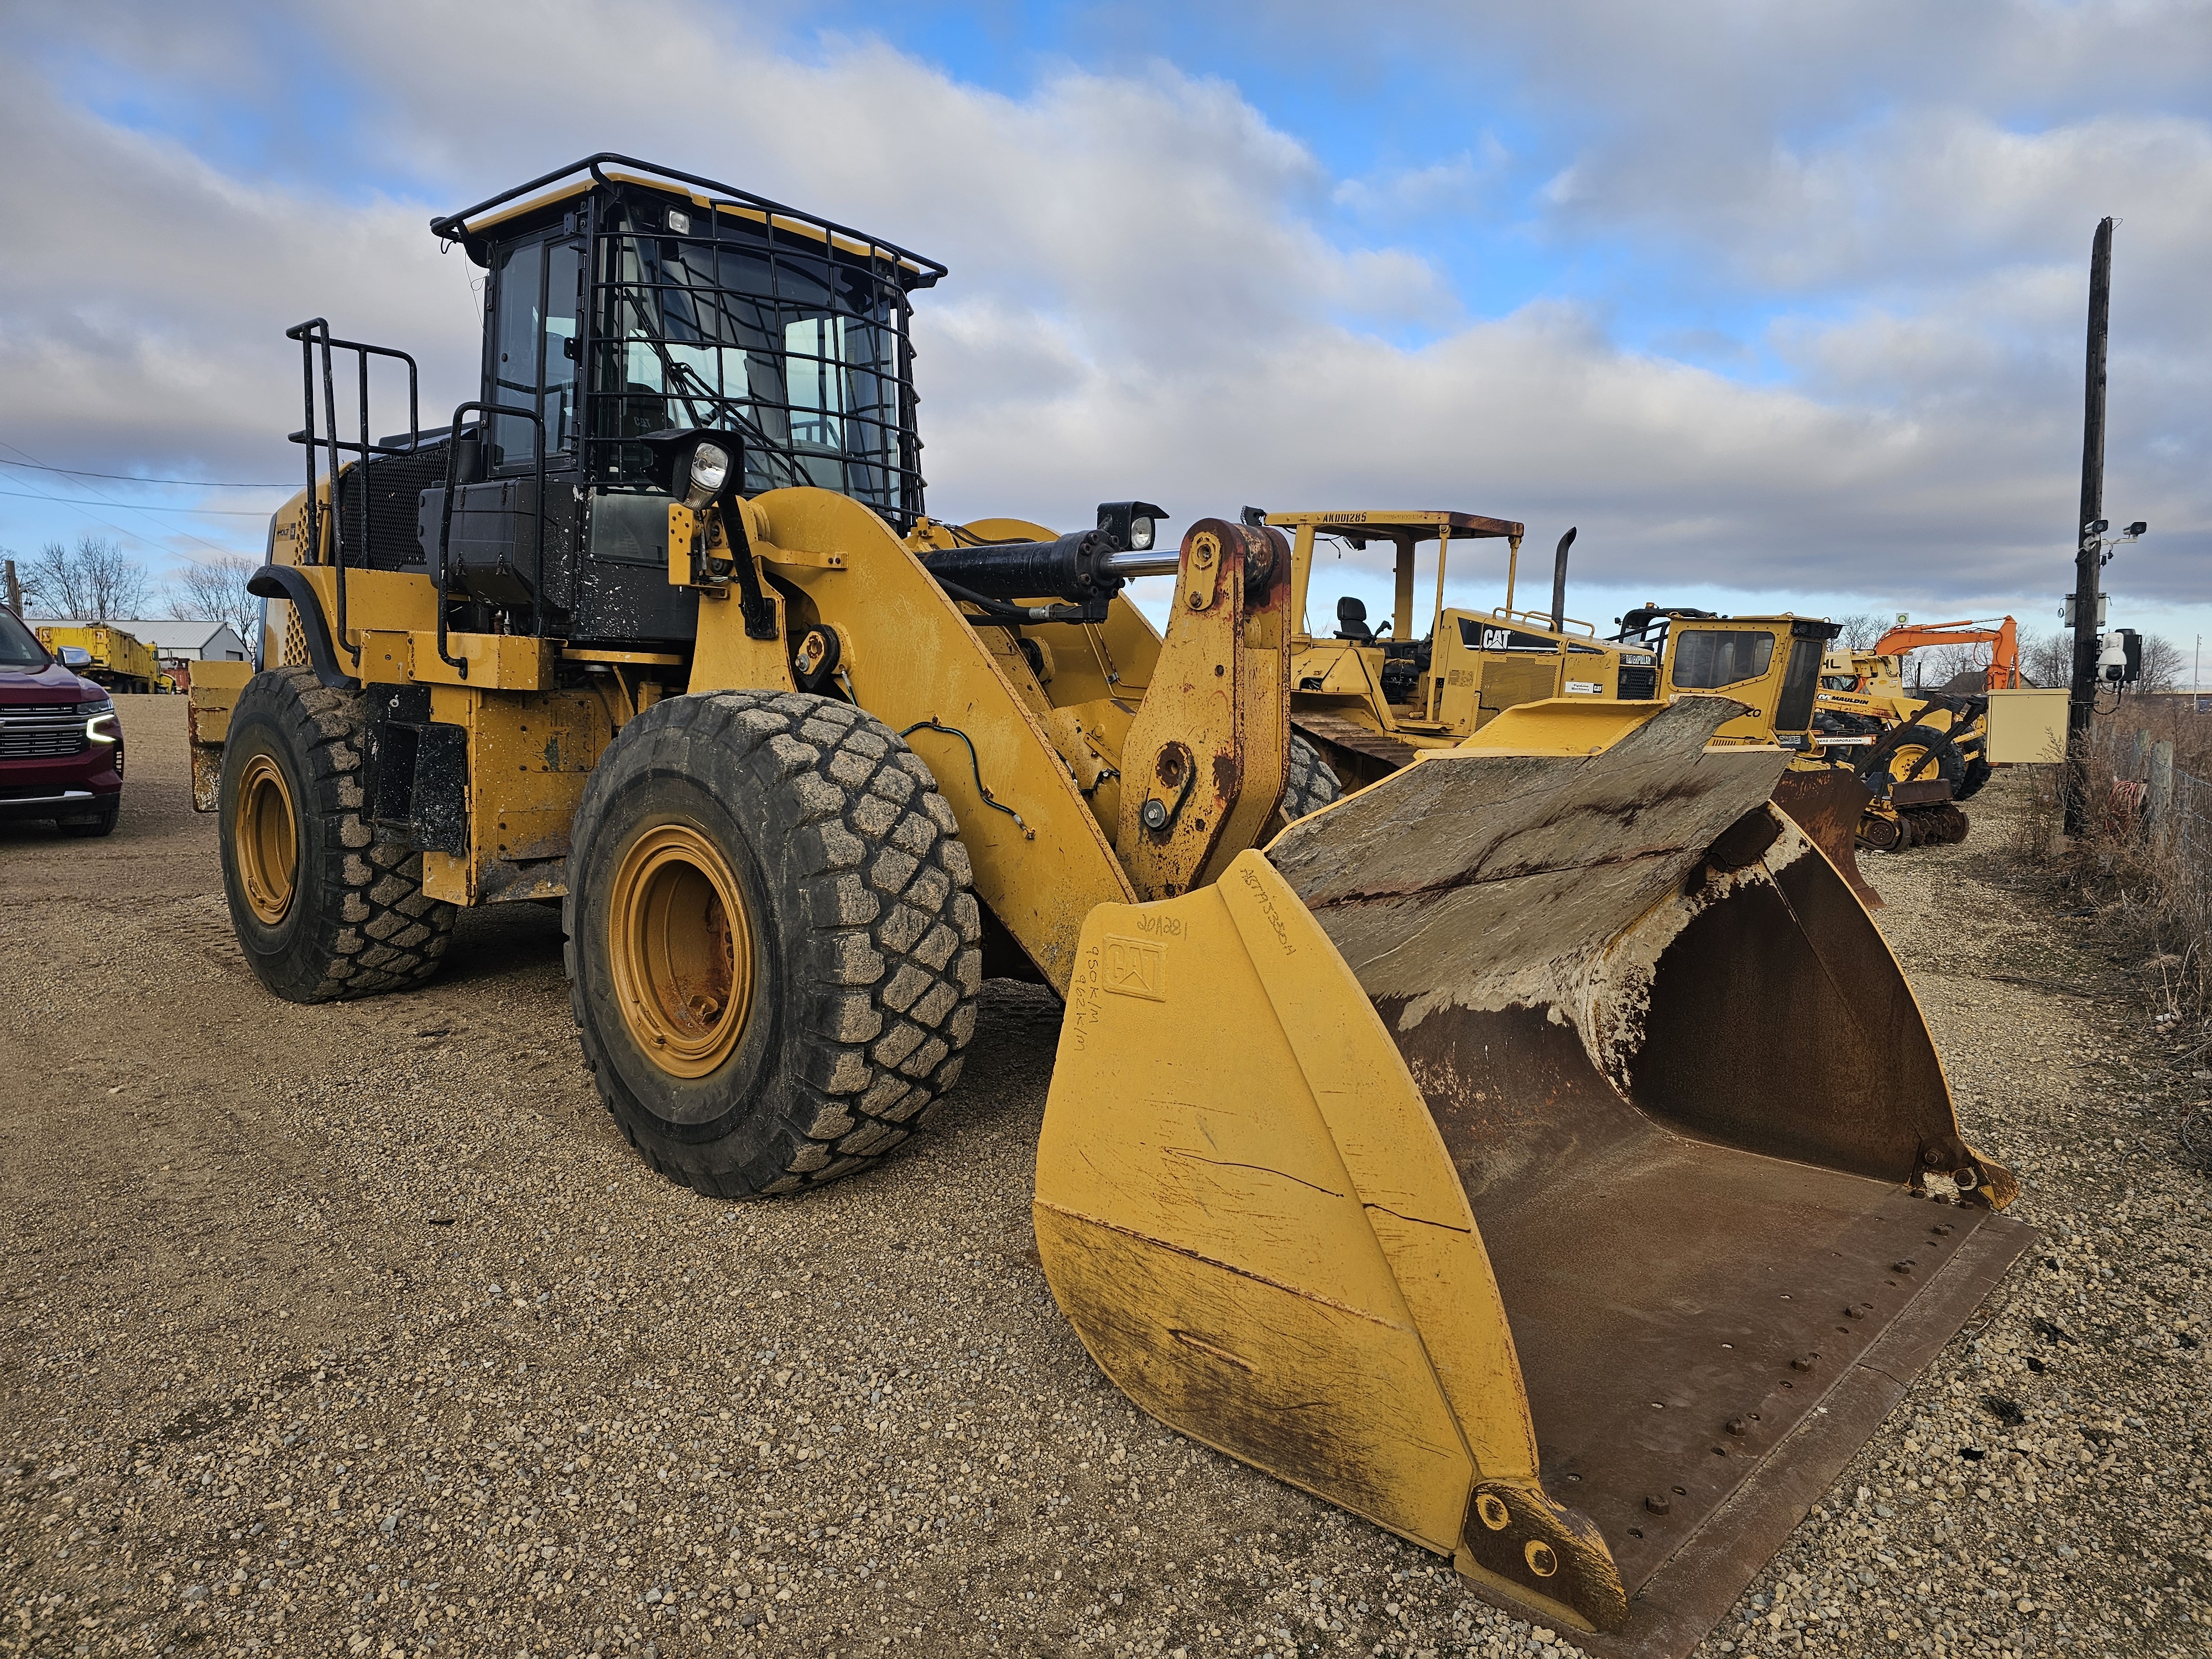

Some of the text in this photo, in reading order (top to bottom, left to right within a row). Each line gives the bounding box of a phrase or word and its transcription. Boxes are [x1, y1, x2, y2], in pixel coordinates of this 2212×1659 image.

[1483, 629, 1511, 649] CAT
[1832, 696, 1869, 705] MAULDIN
[1107, 943, 1160, 993] CAT
